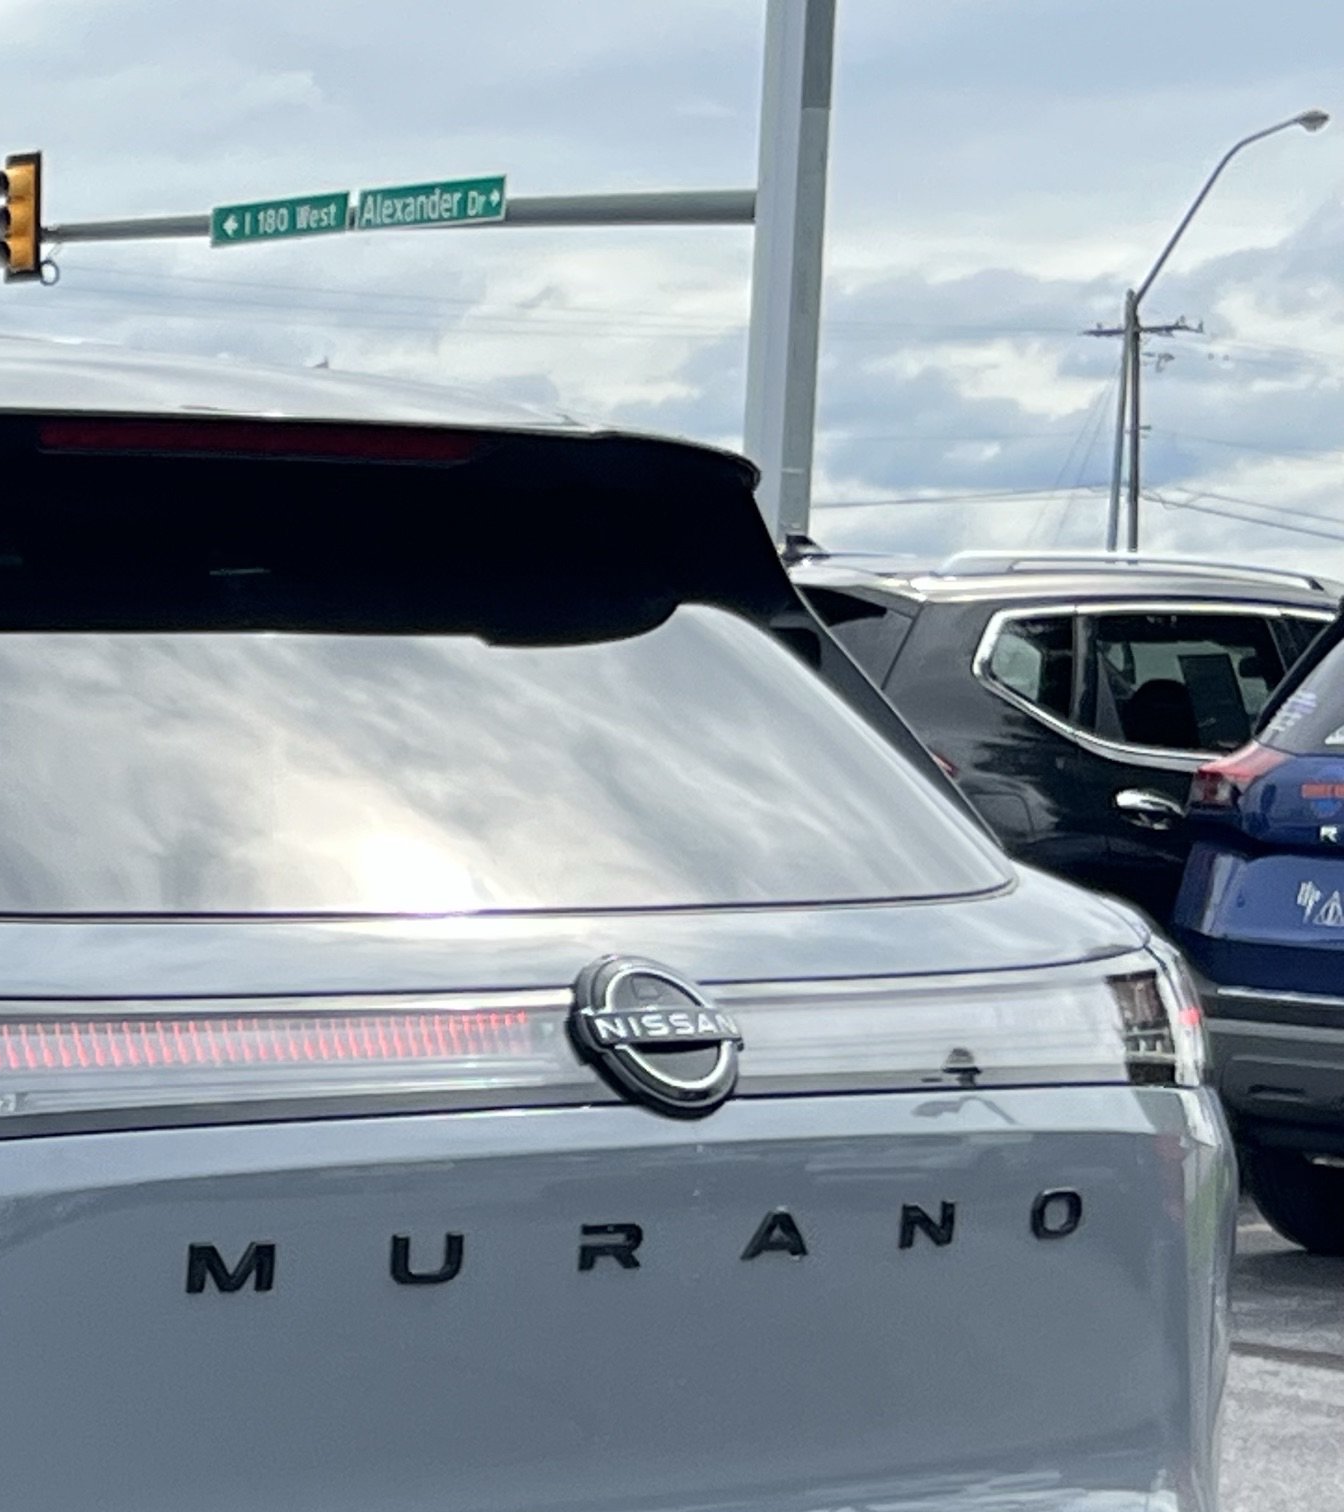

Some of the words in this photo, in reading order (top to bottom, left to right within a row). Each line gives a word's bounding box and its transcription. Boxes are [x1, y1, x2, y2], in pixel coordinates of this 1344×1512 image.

[244, 212, 251, 235] I
[257, 207, 289, 233] 180
[296, 202, 336, 230] West
[362, 187, 462, 227] Alexander
[467, 191, 486, 216] Dr
[593, 1012, 739, 1040] NISSAN
[185, 1189, 1083, 1296] MURANO
